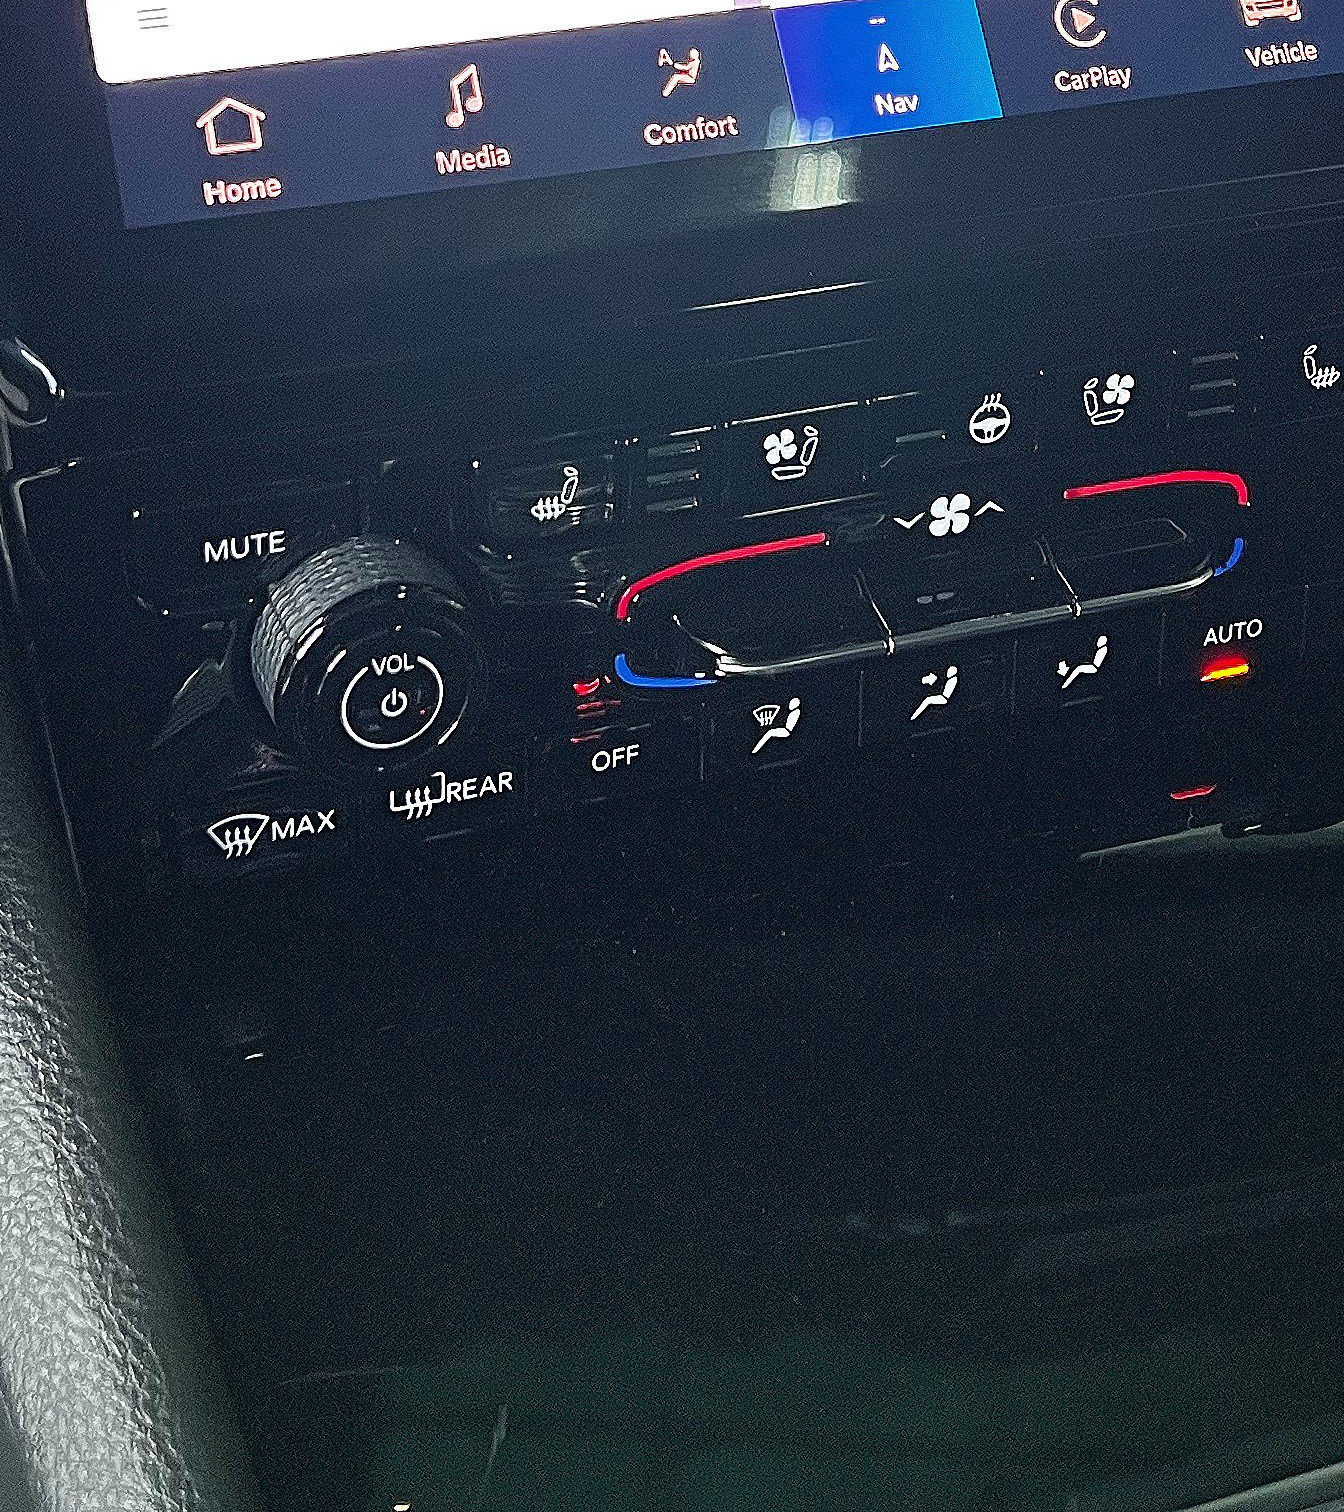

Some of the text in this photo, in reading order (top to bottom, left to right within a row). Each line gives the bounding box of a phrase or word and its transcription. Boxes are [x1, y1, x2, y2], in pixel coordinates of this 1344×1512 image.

[1244, 39, 1319, 68] Vehicle
[1053, 62, 1133, 94] CarPlay
[873, 91, 919, 116] Nav
[642, 114, 739, 146] Comfort
[434, 142, 511, 176] Media
[202, 175, 282, 206] Home
[203, 529, 287, 563] MUTE
[1202, 618, 1263, 648] AUTO
[371, 652, 415, 676] VOL
[591, 743, 640, 772] OFF
[445, 772, 513, 803] REAR
[271, 808, 336, 842] MAX
